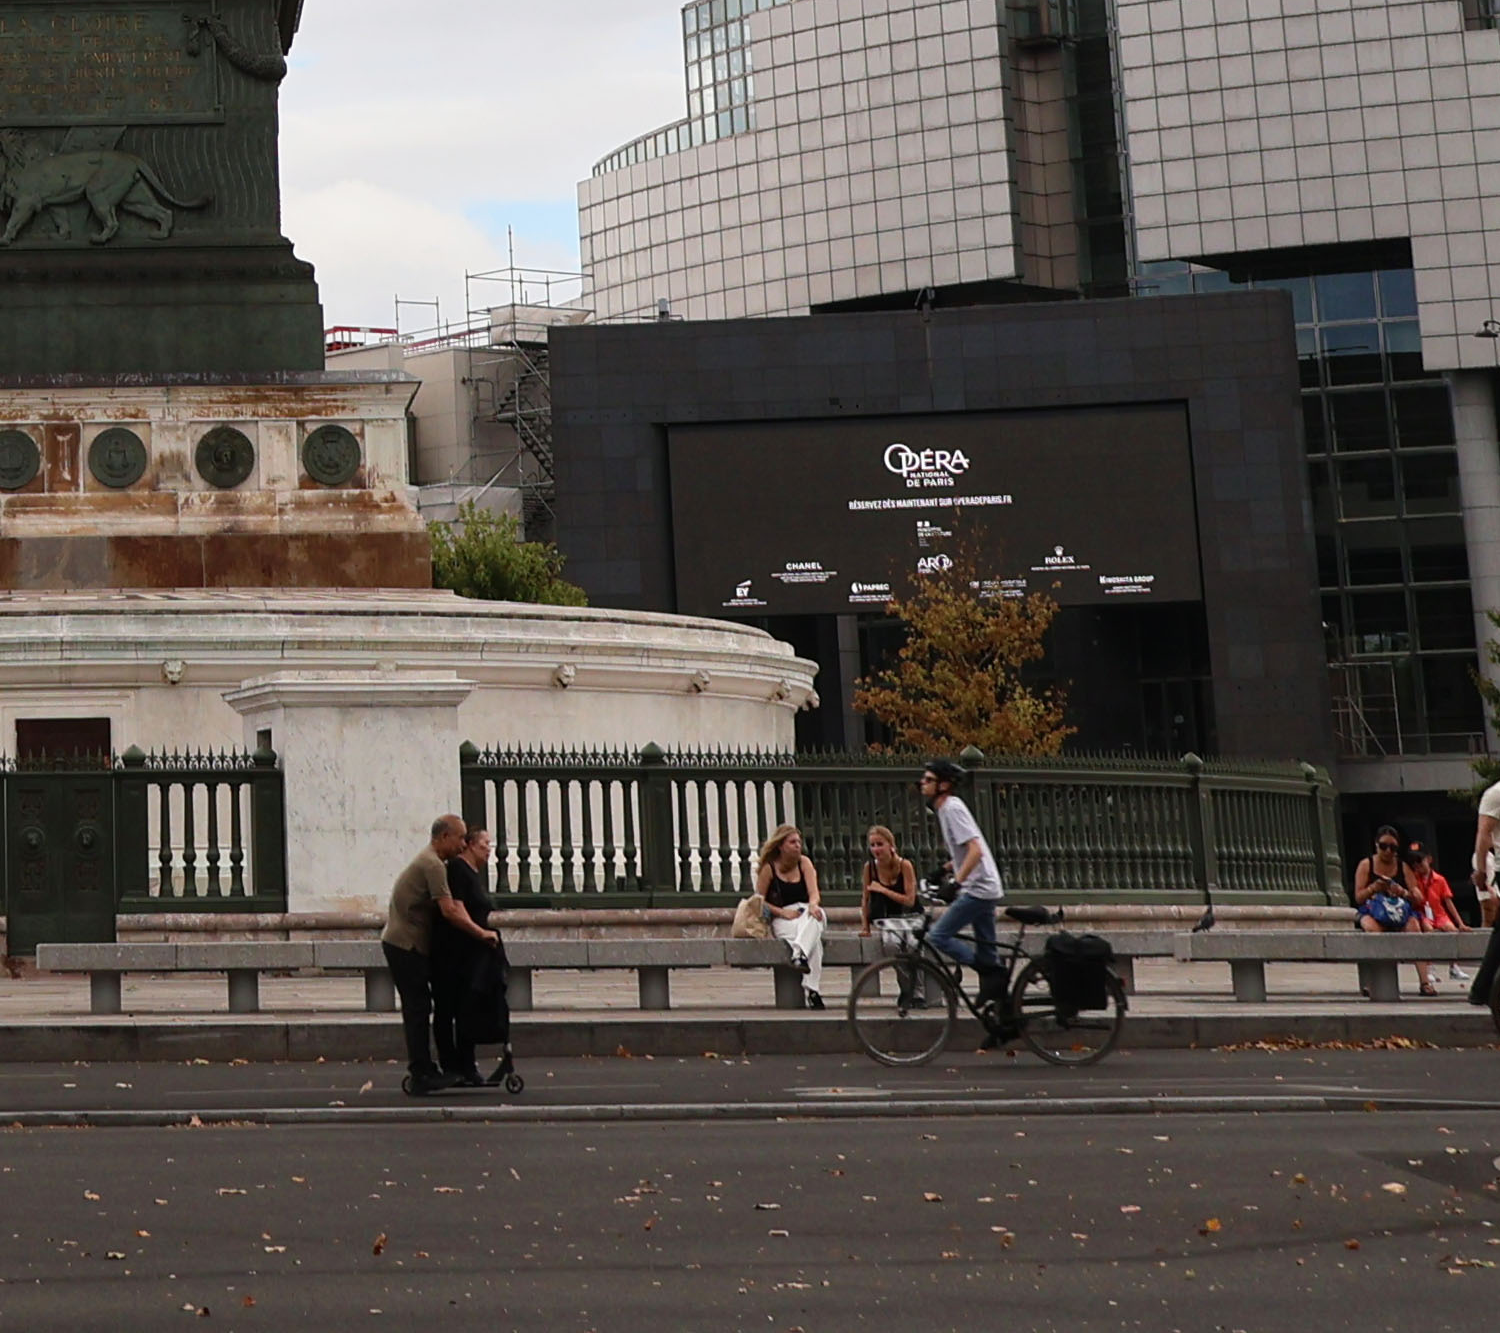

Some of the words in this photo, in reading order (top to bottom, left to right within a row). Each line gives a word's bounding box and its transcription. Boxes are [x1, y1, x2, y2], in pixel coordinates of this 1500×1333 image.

[884, 443, 970, 477] OPÉRA
[910, 470, 950, 478] NATIONAL
[906, 479, 920, 488] DE
[924, 477, 954, 487] PARIS
[848, 498, 882, 510] RÉSERVEZ
[897, 497, 938, 509] MAINTENANT
[939, 497, 952, 507] SUR
[1045, 556, 1075, 564] ROLEX
[786, 562, 822, 571] CHANEL
[736, 587, 749, 597] EY
